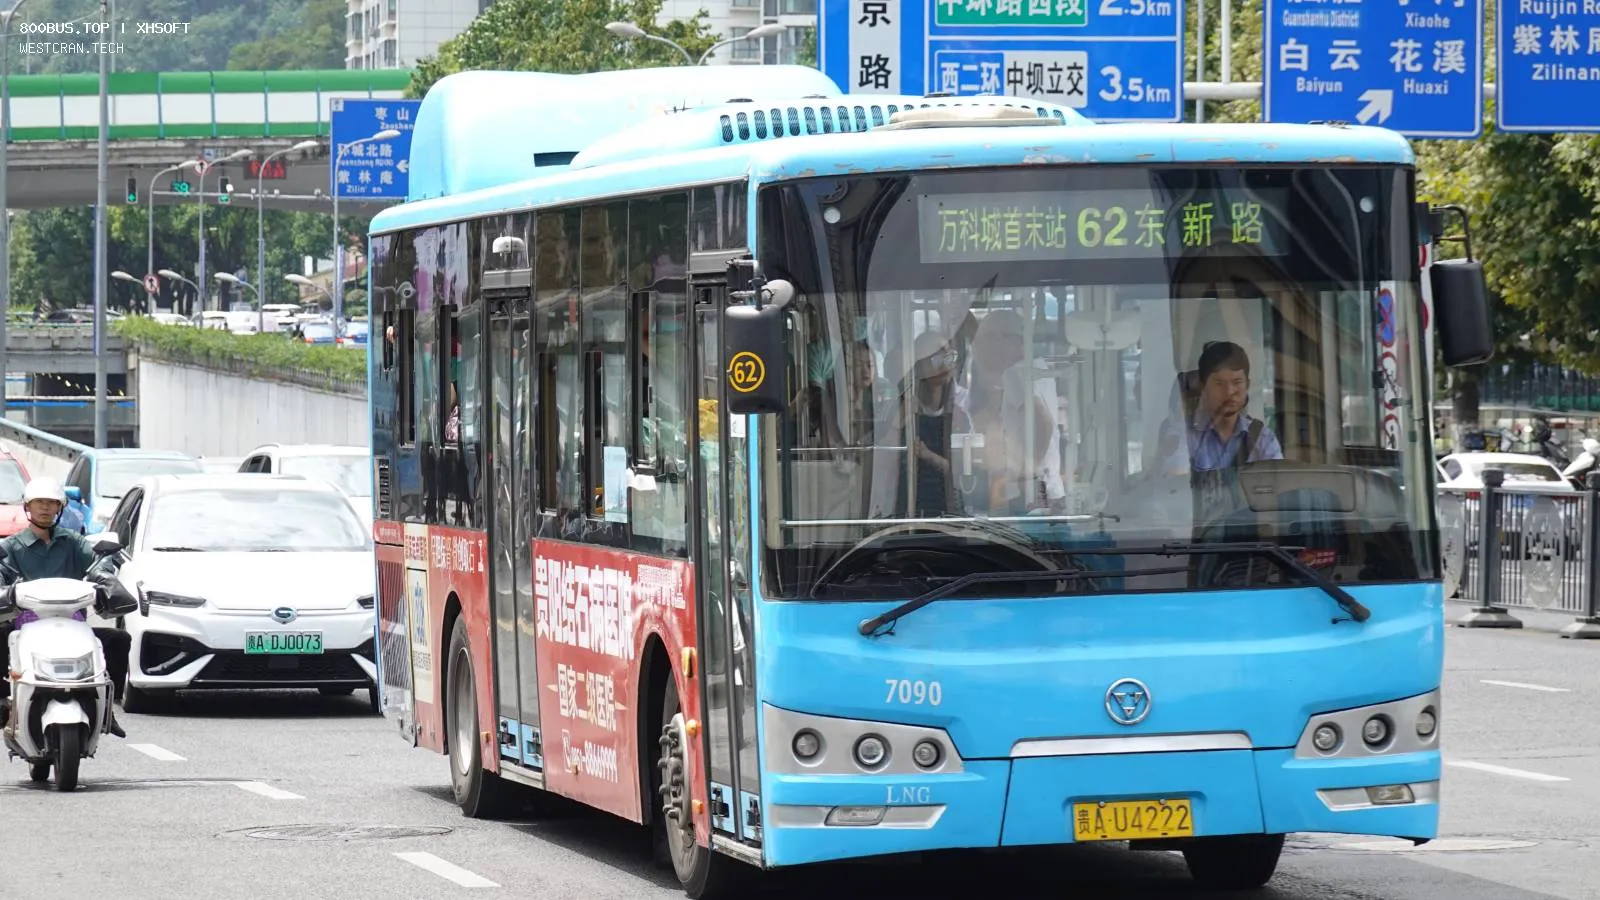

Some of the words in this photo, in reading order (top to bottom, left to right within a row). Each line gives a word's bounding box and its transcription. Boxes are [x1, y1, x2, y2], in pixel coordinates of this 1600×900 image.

[1405, 12, 1450, 28] Xiaohe
[1520, 0, 1577, 19] Ruijin
[1279, 38, 1362, 71] 白云
[1390, 39, 1466, 74] 花溪
[940, 62, 1000, 95] 西二环
[1006, 61, 1084, 96] 中坝立交
[1099, 65, 1171, 103] 3.5km
[1296, 77, 1343, 94] Baiyun
[1403, 78, 1449, 95] Huaxi
[938, 206, 1067, 252] 万科城首末站
[1077, 207, 1128, 248] 62
[1135, 203, 1264, 248] 东新路
[734, 361, 757, 383] 62
[535, 554, 635, 660] 贵阳结石病医院
[557, 663, 617, 732] 国家二级医院
[885, 679, 942, 706] 7090
[886, 784, 931, 804] LNG
